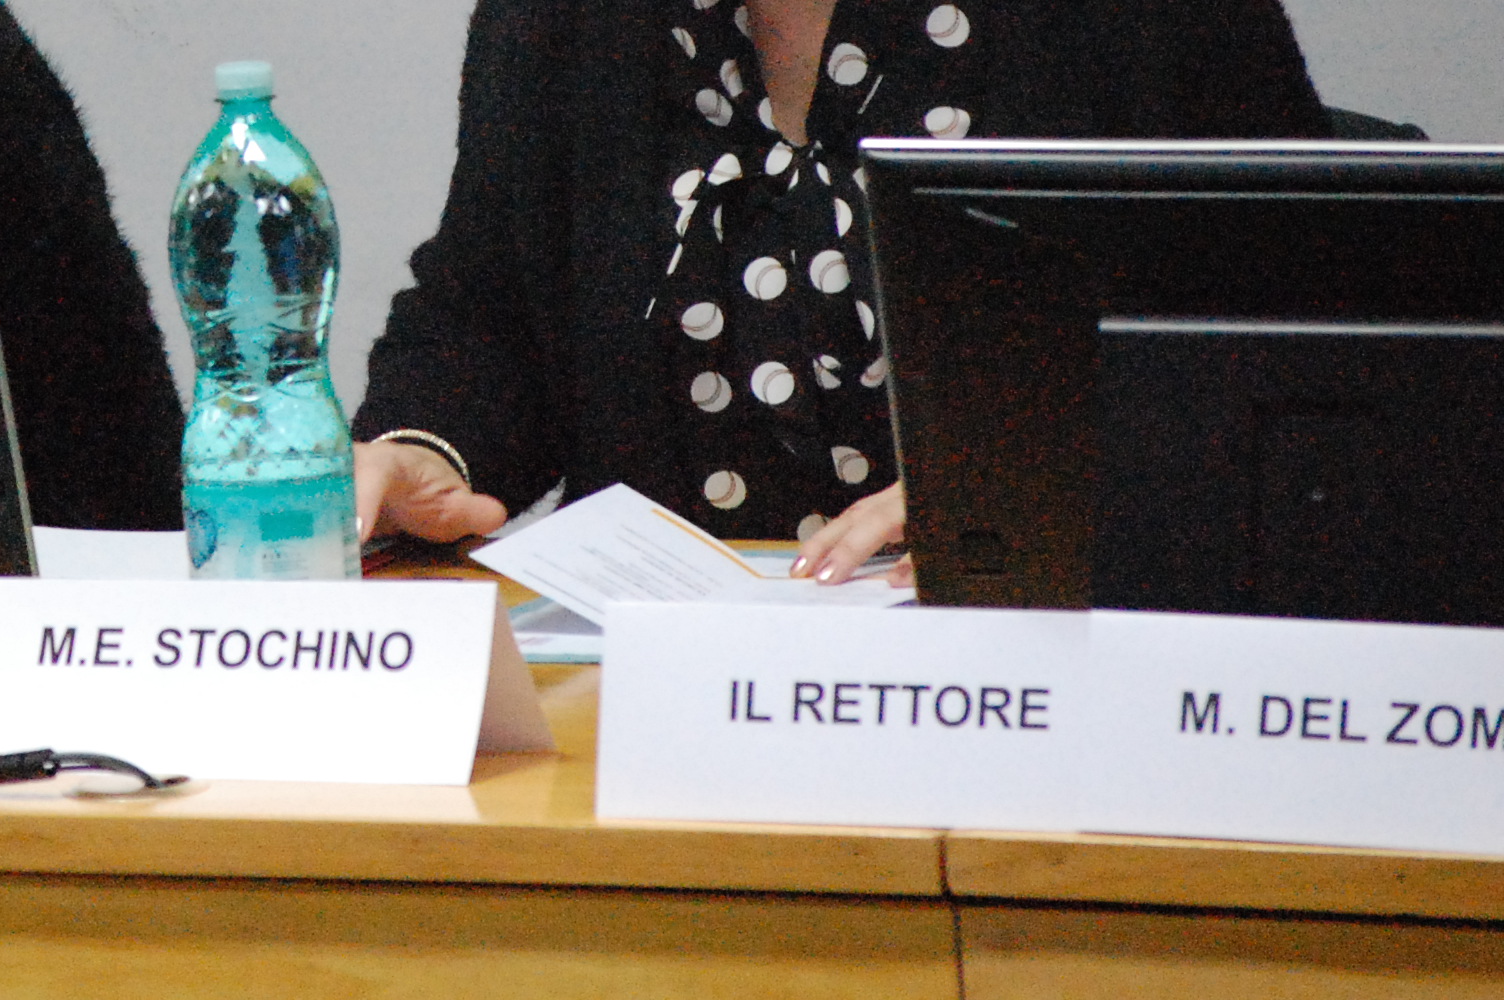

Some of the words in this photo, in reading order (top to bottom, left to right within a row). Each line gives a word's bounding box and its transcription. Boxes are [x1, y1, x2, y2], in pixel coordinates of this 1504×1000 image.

[37, 626, 133, 667] M.E.
[152, 628, 414, 671] STOCHINO
[729, 680, 772, 723] IL
[792, 681, 1051, 731] RETTORE
[1179, 690, 1236, 737] M.
[1258, 694, 1368, 744] DEL
[1385, 701, 1504, 750] ZOM
